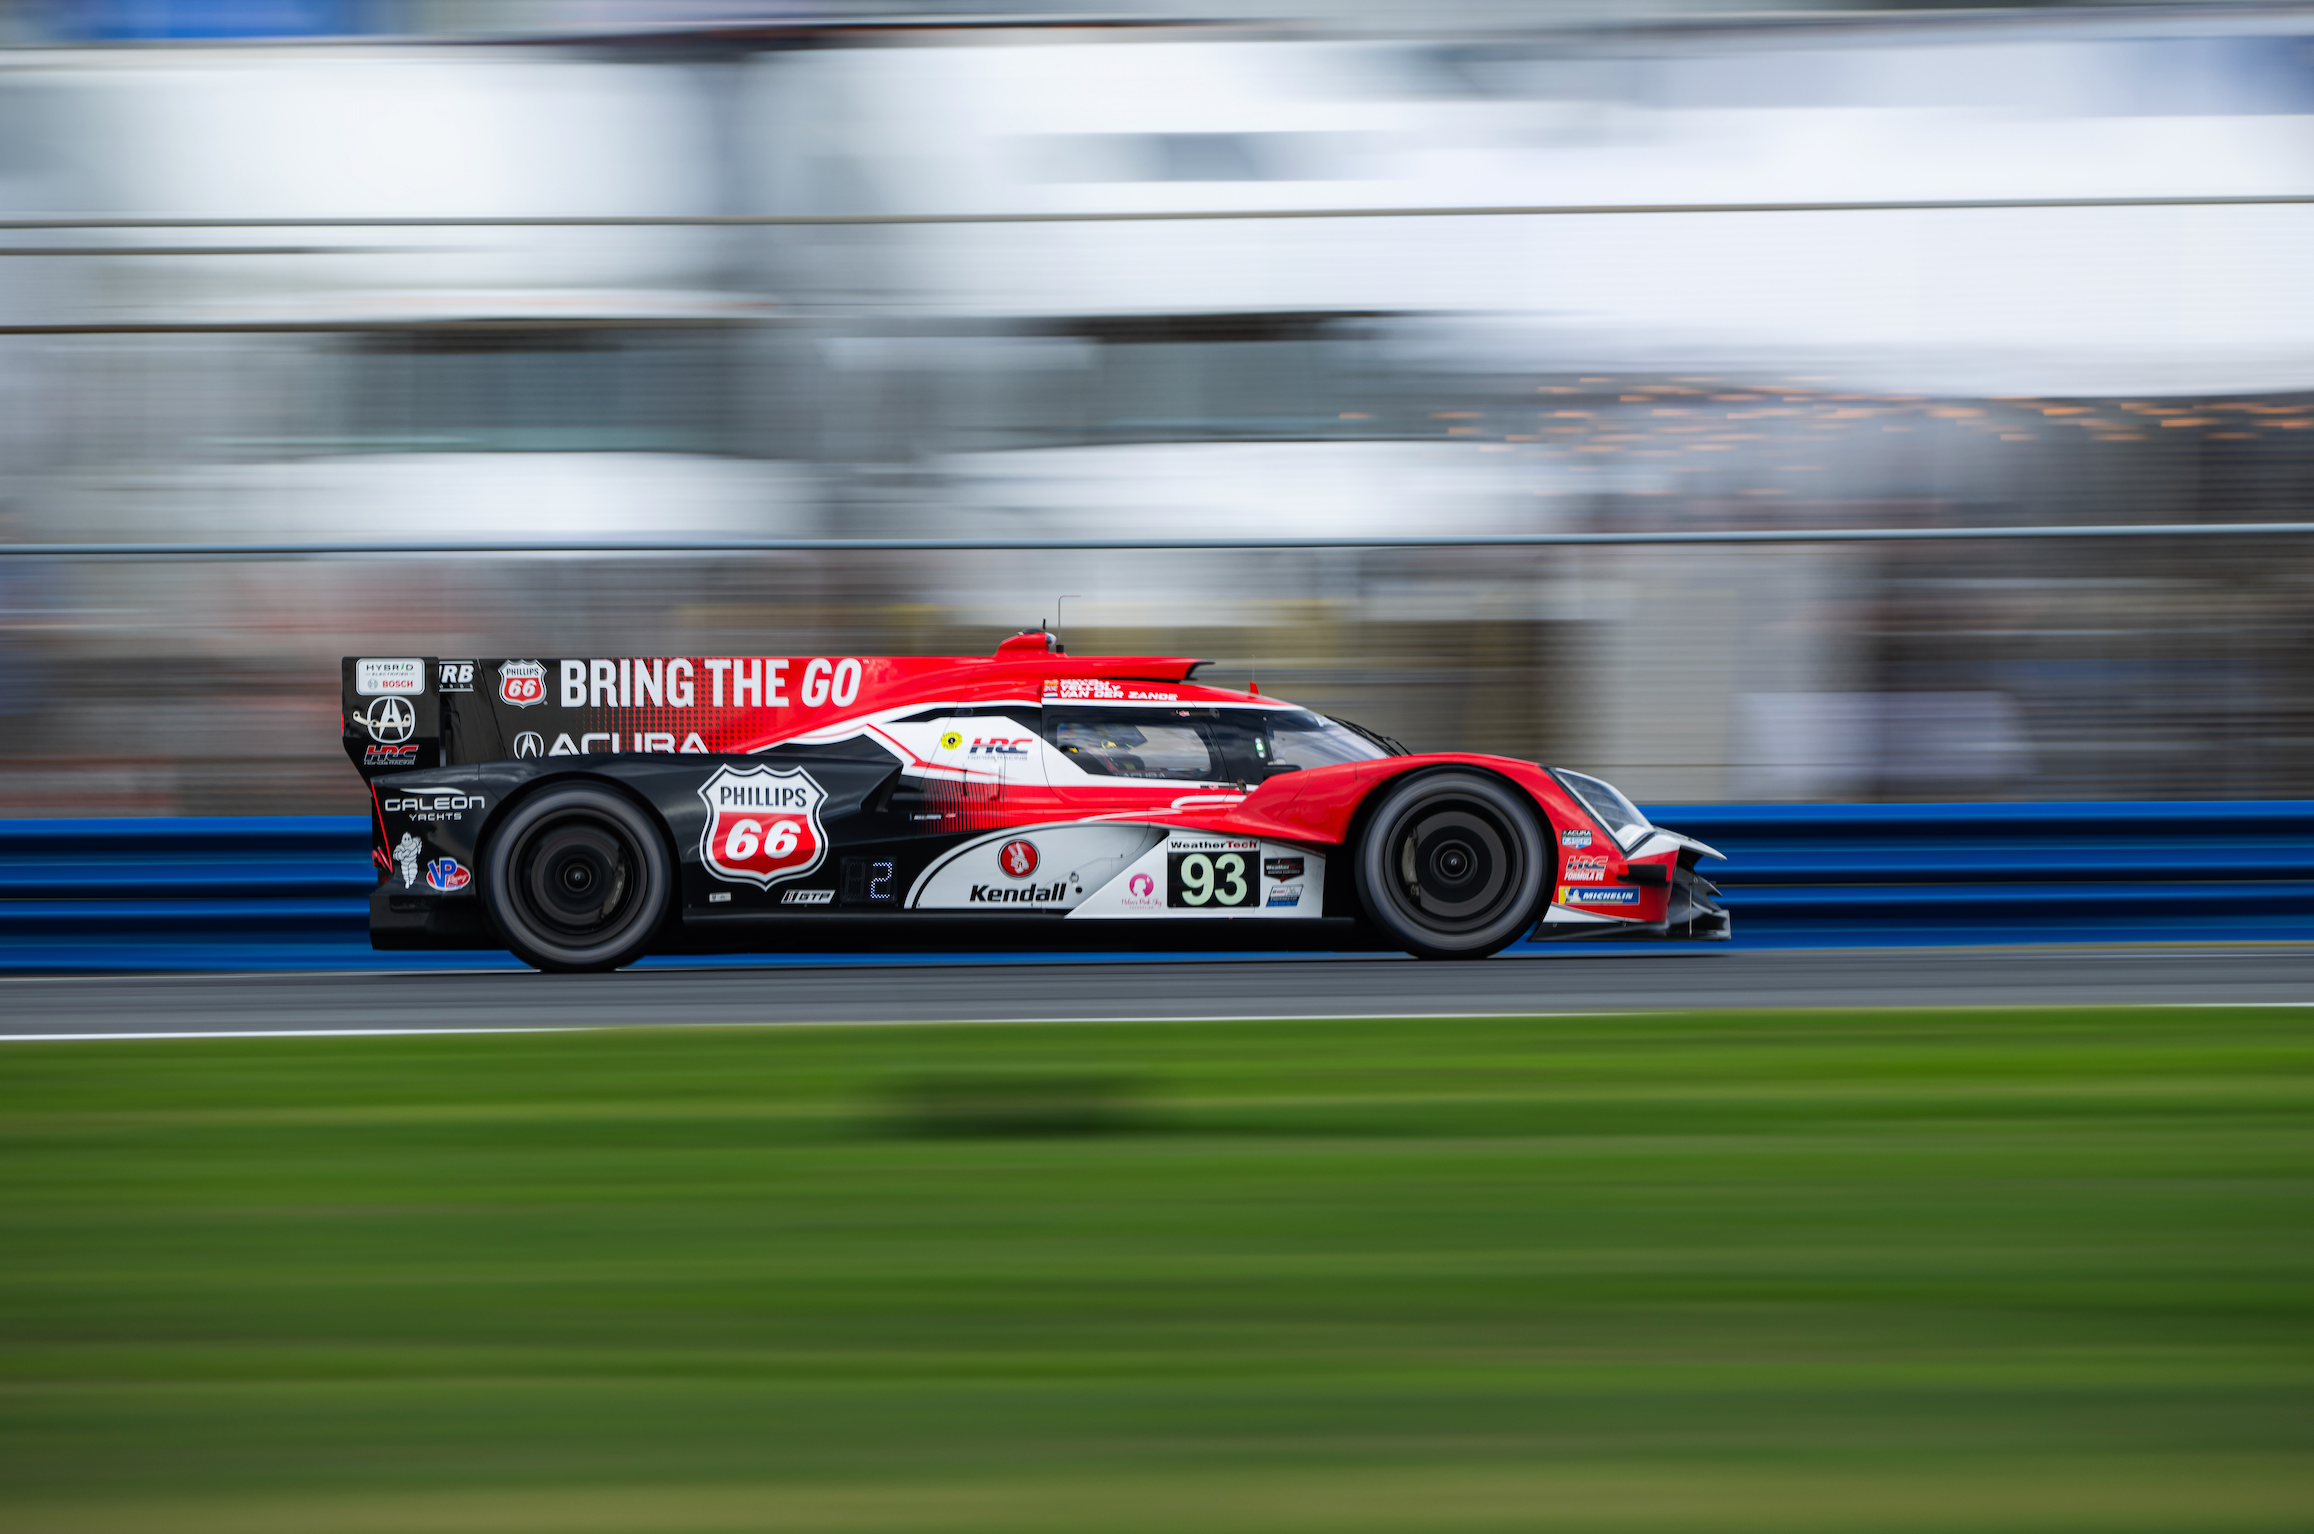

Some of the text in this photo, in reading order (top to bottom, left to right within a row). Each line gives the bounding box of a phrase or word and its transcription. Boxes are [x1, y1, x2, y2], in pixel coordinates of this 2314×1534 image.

[366, 662, 414, 671] HYBRID
[439, 665, 474, 683] RB
[506, 664, 539, 676] PHILLIPS
[382, 680, 413, 688] BOSCH
[508, 679, 536, 697] 66
[560, 658, 694, 708] BRING
[704, 659, 789, 707] THE
[801, 658, 862, 708] GO
[1060, 690, 1178, 701] VAN DER ZANDE
[549, 732, 709, 756] ACURA
[969, 737, 1033, 754] HRC
[364, 745, 419, 761] HRC
[385, 796, 485, 811] GALEON
[720, 786, 807, 807] PHILLIPS
[409, 812, 462, 821] YACHTS
[725, 818, 801, 861] 66
[1170, 840, 1257, 849] WeatherTech
[1565, 855, 1608, 869] HRC
[427, 857, 457, 888] VP
[870, 862, 892, 899] 2
[1181, 853, 1247, 906] 93
[1564, 872, 1595, 881] FORMULA
[799, 892, 830, 901] GTP
[969, 883, 1067, 902] Kendall
[1583, 892, 1633, 900] MICHELIN
